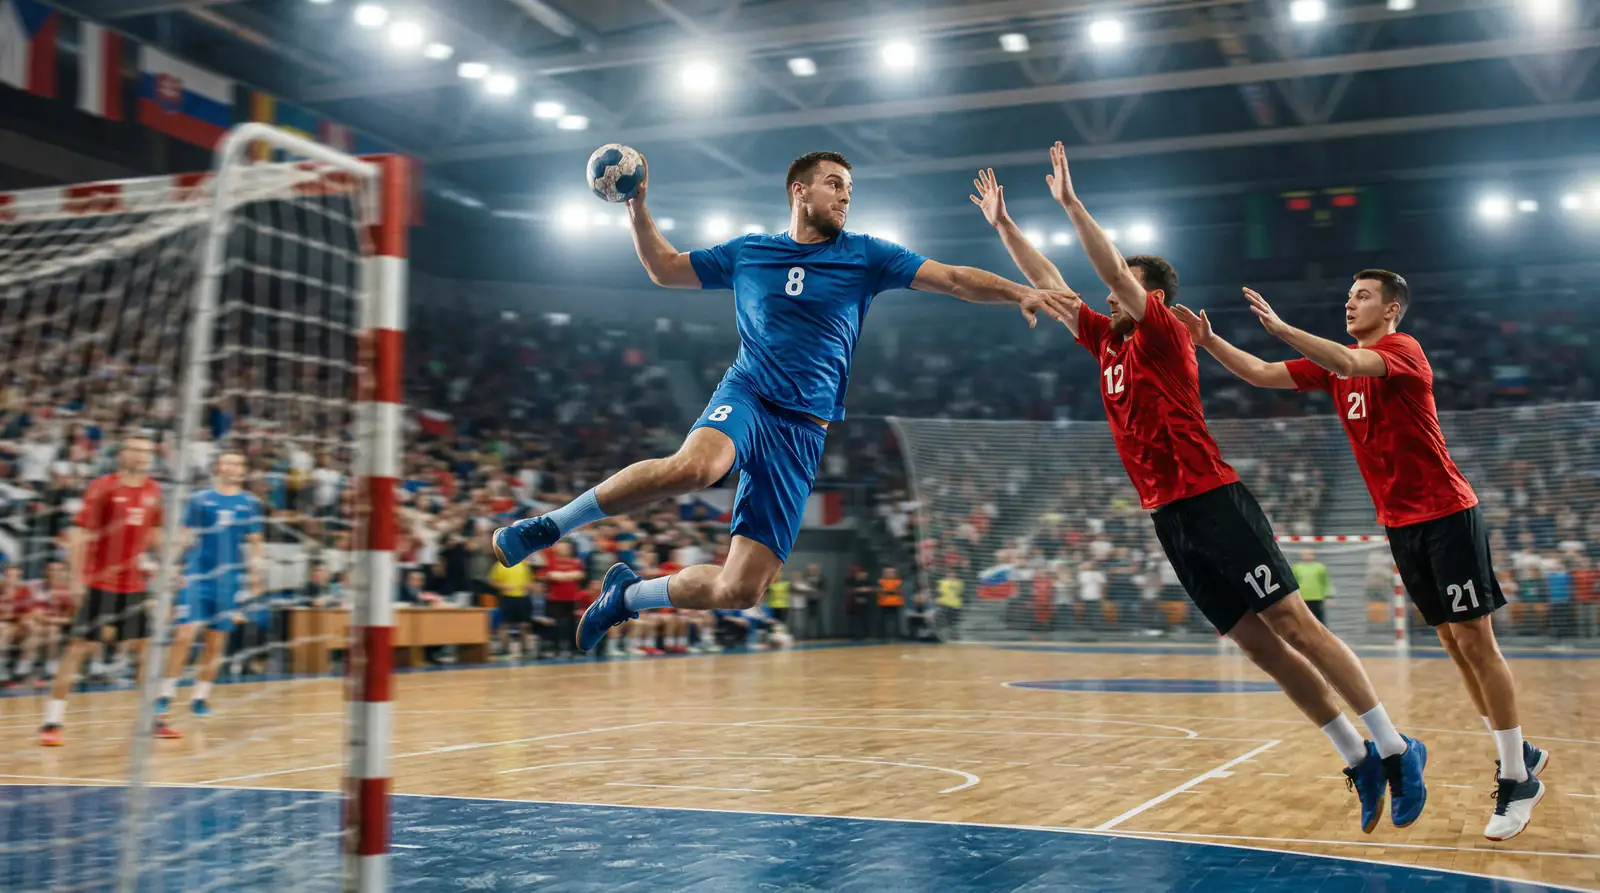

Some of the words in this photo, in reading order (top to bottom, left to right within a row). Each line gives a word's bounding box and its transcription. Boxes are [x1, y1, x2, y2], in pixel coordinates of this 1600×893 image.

[785, 266, 806, 296] 8
[1103, 364, 1125, 395] 12
[708, 405, 733, 422] 8
[1347, 391, 1367, 420] 21
[1243, 564, 1281, 599] 12
[1446, 579, 1480, 613] 21
